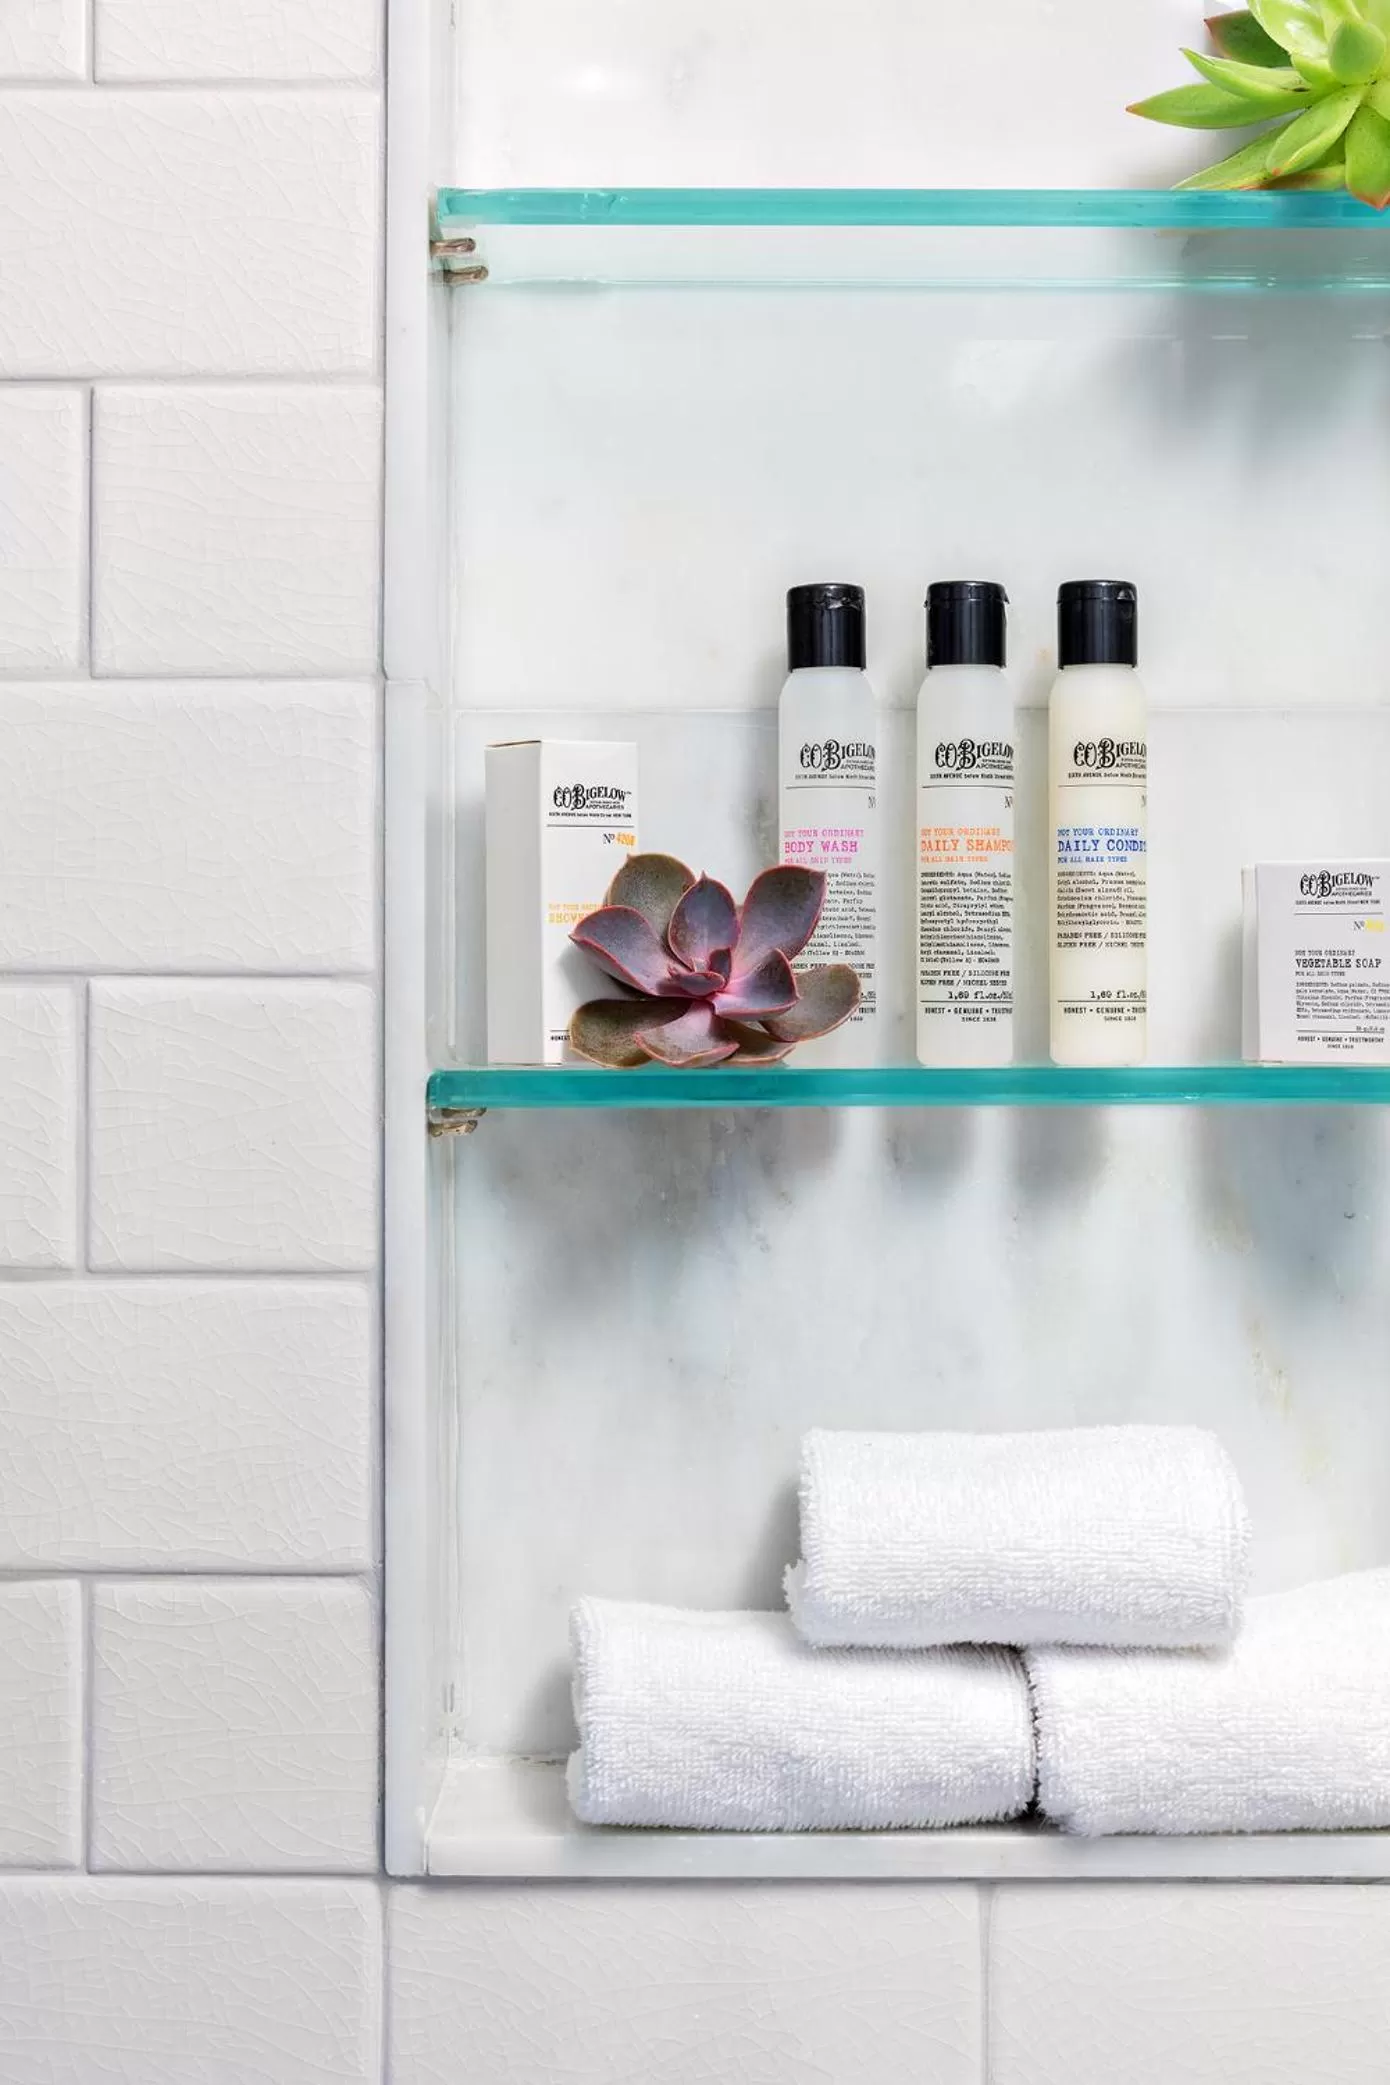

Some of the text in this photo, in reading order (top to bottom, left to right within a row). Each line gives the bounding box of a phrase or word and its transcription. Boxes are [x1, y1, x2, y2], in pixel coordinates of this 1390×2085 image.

[784, 841, 858, 853] BODY WASH
[921, 839, 960, 851] DAILY
[1058, 839, 1100, 852] DAILY
[1296, 958, 1382, 968] VEGETABLE SOAP
